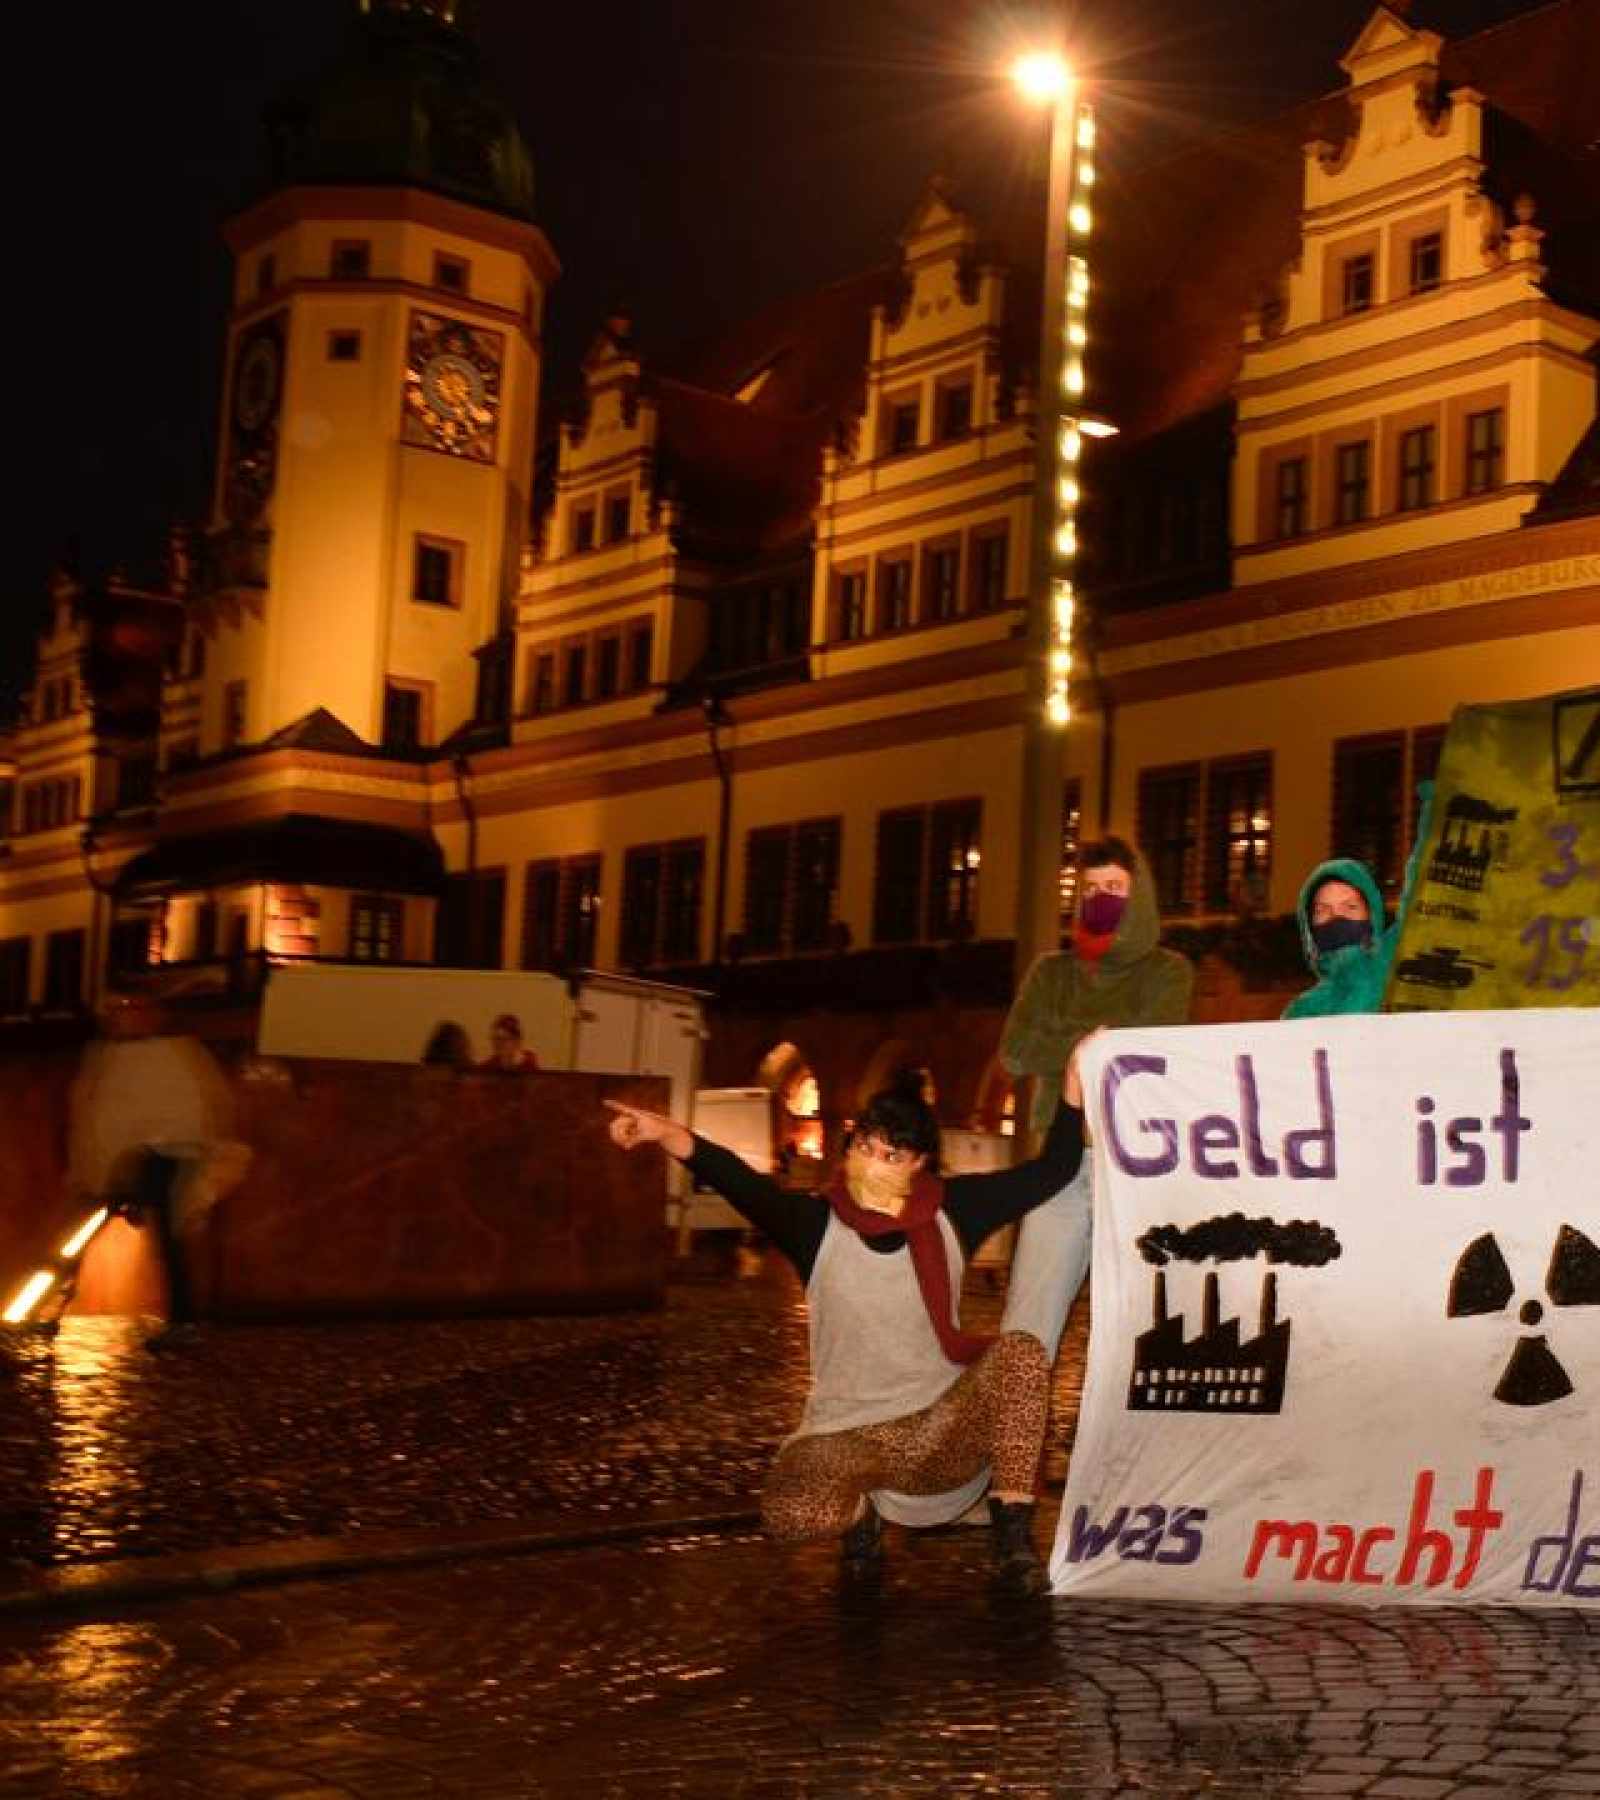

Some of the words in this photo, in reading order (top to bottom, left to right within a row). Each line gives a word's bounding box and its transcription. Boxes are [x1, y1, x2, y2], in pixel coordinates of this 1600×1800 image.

[1104, 1048, 1336, 1180] Geld
[1416, 1048, 1532, 1185] ist
[1064, 1505, 1208, 1565] was
[1243, 1467, 1504, 1591] macht
